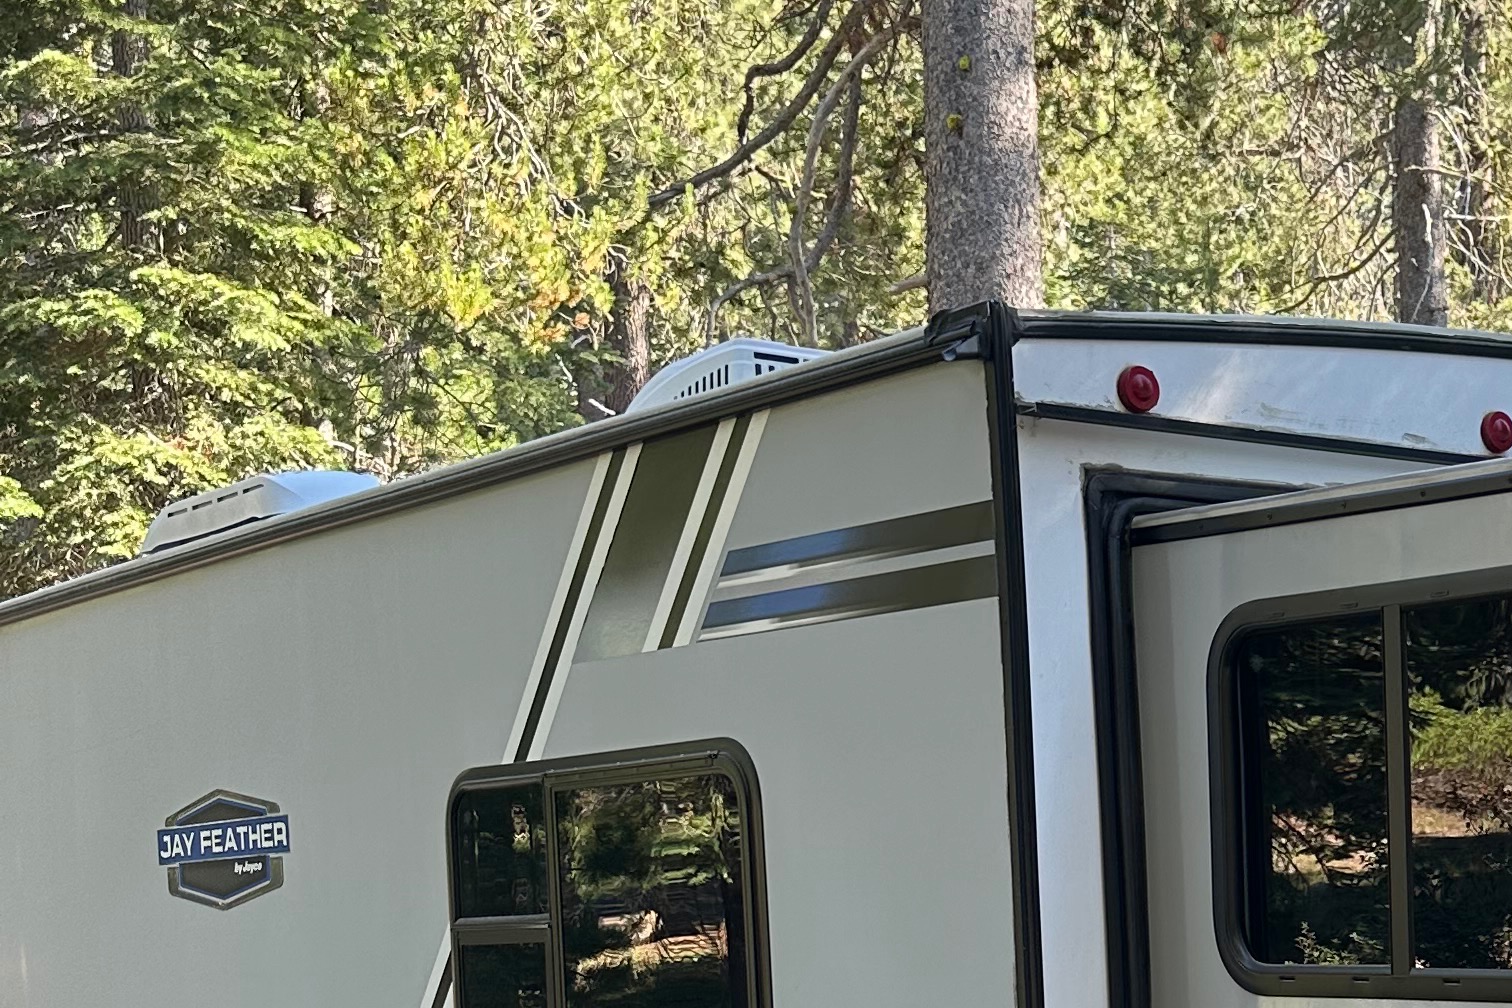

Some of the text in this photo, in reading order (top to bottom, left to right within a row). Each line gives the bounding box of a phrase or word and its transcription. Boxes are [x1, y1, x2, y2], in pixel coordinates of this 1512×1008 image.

[160, 821, 288, 859] JAY FEATHER
[234, 860, 263, 875] by Jayco
